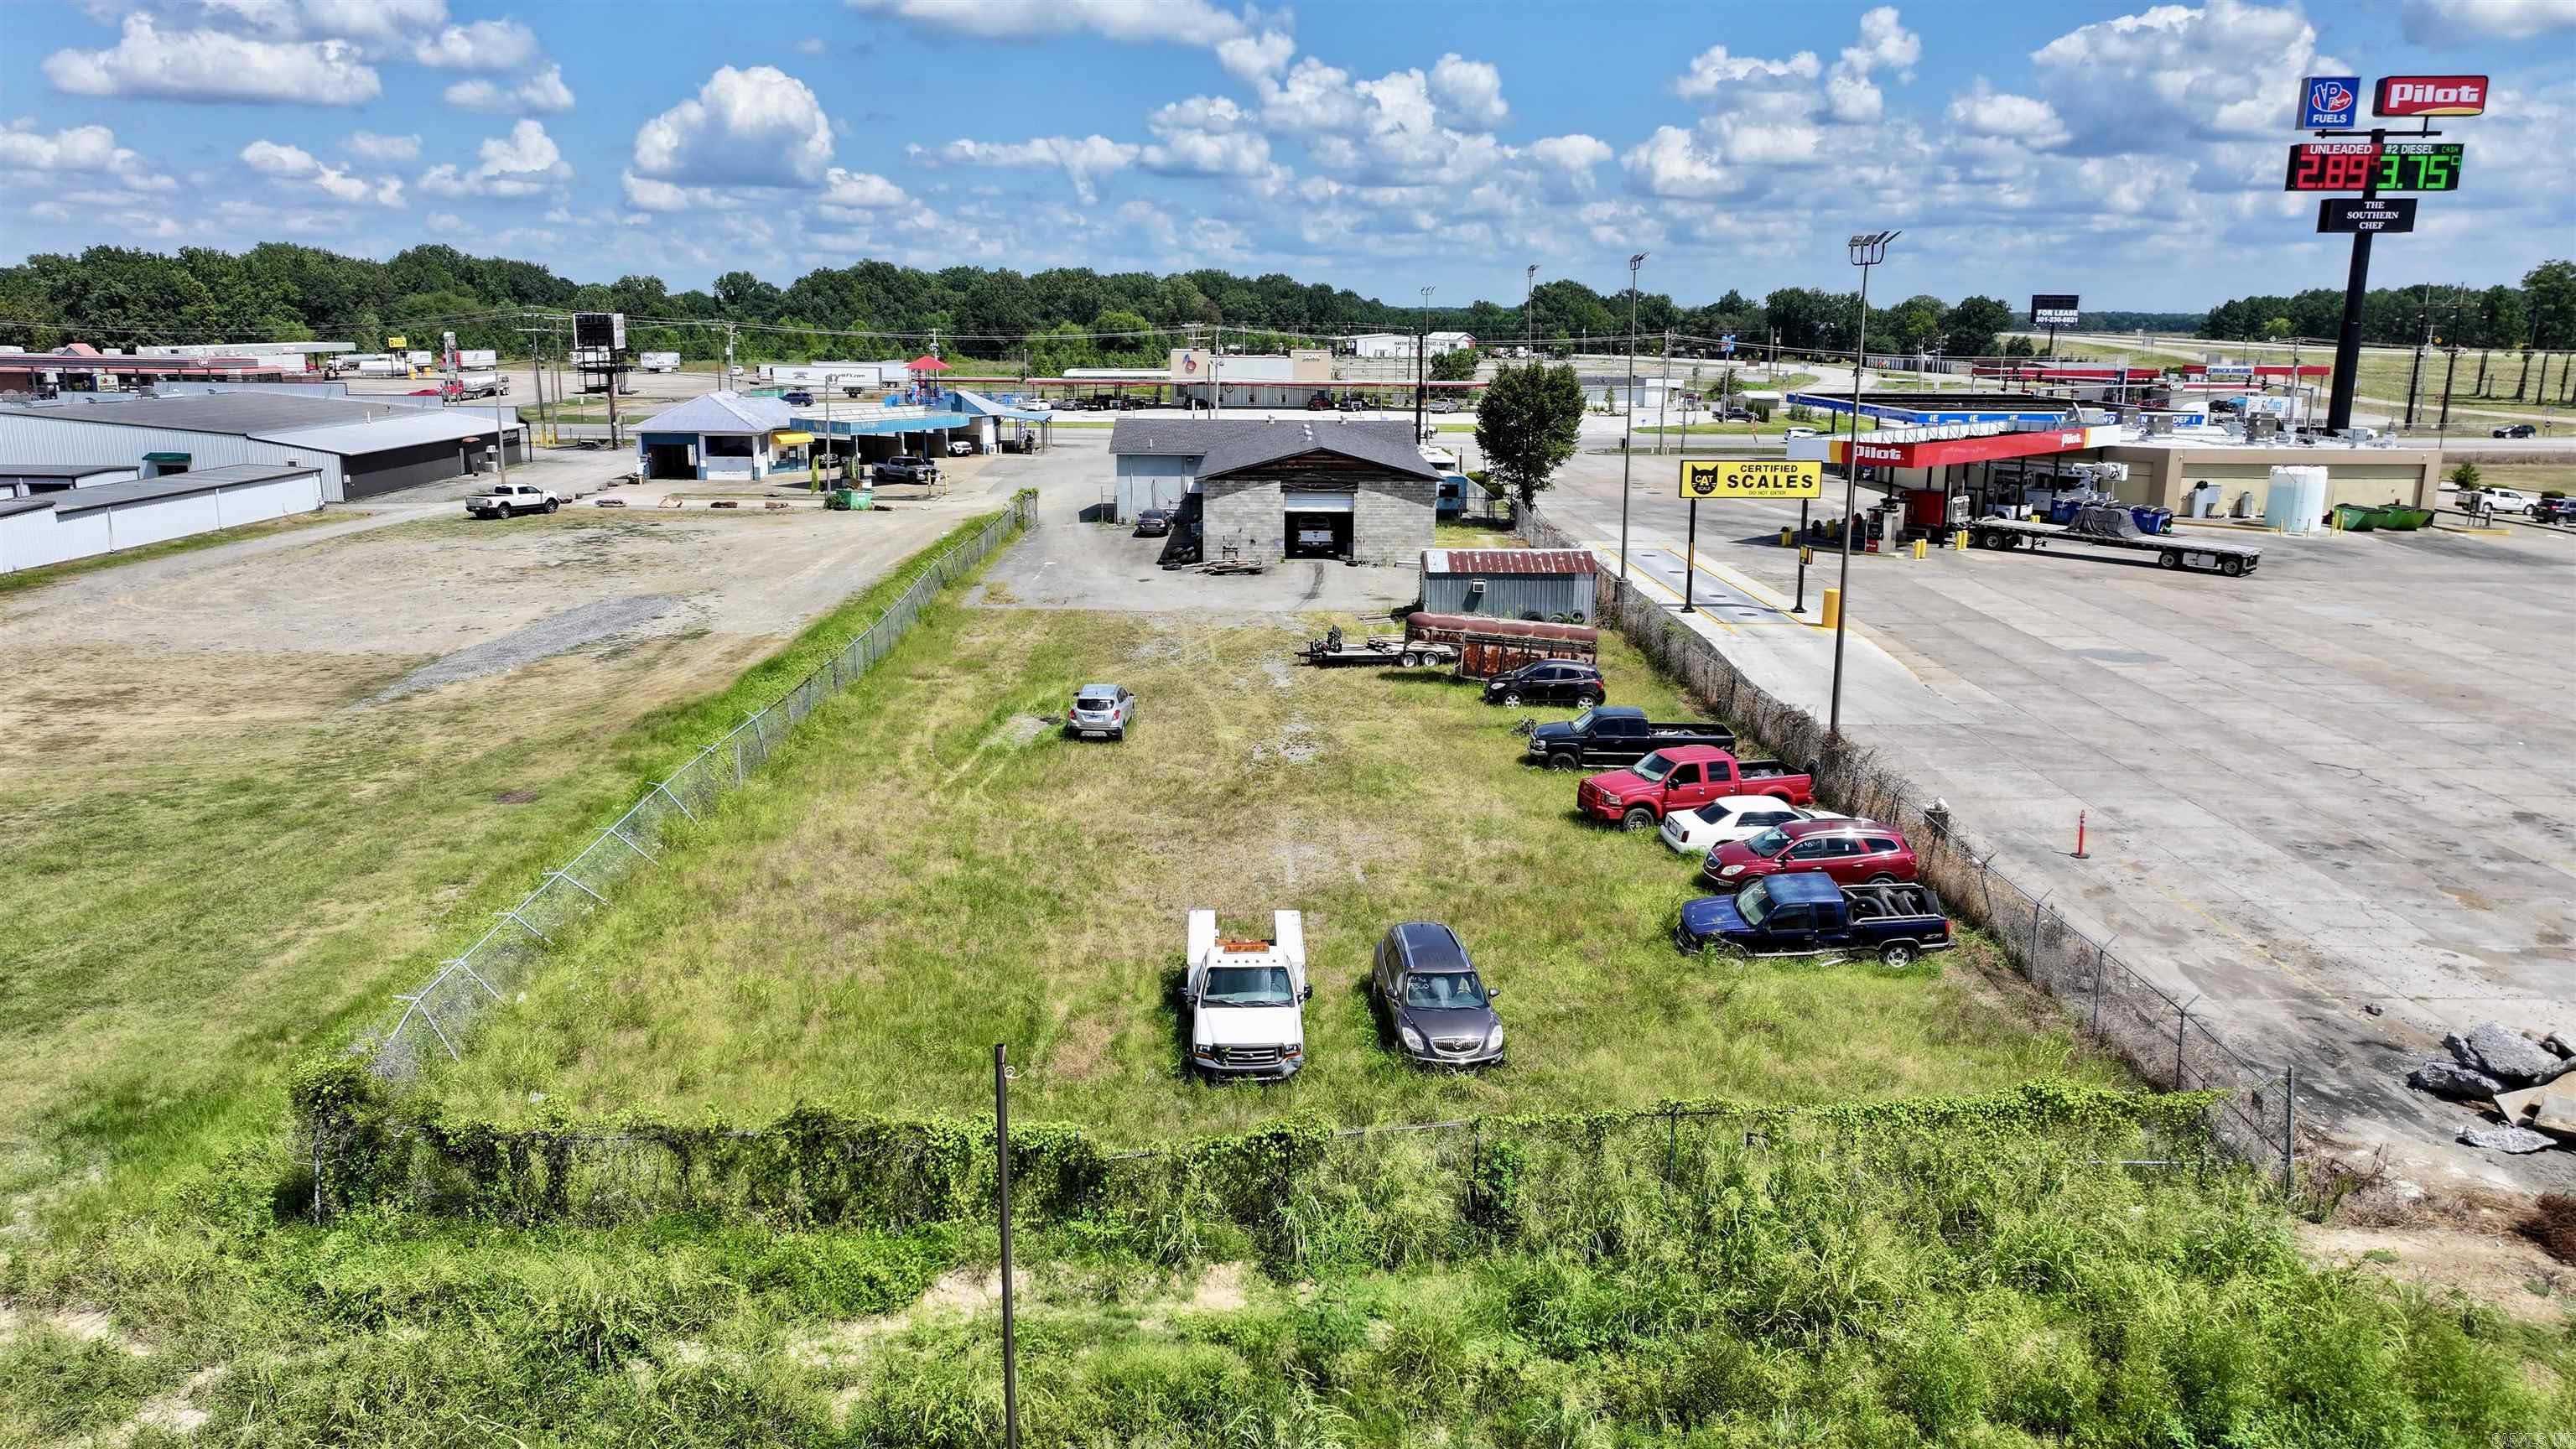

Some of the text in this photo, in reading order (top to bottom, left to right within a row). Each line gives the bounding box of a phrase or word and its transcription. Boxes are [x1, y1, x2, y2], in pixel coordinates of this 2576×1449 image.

[2314, 82, 2342, 111] VP
[2389, 84, 2480, 108] Pilot
[2313, 114, 2347, 123] FUELS
[2309, 144, 2372, 154] UNLEADED
[2385, 144, 2434, 154] #2 DIESEL
[1856, 445, 1902, 460] Pilot
[1740, 465, 1798, 473] CERTIFIED
[1695, 475, 1714, 486] CAT
[1727, 475, 1813, 488] SCALES
